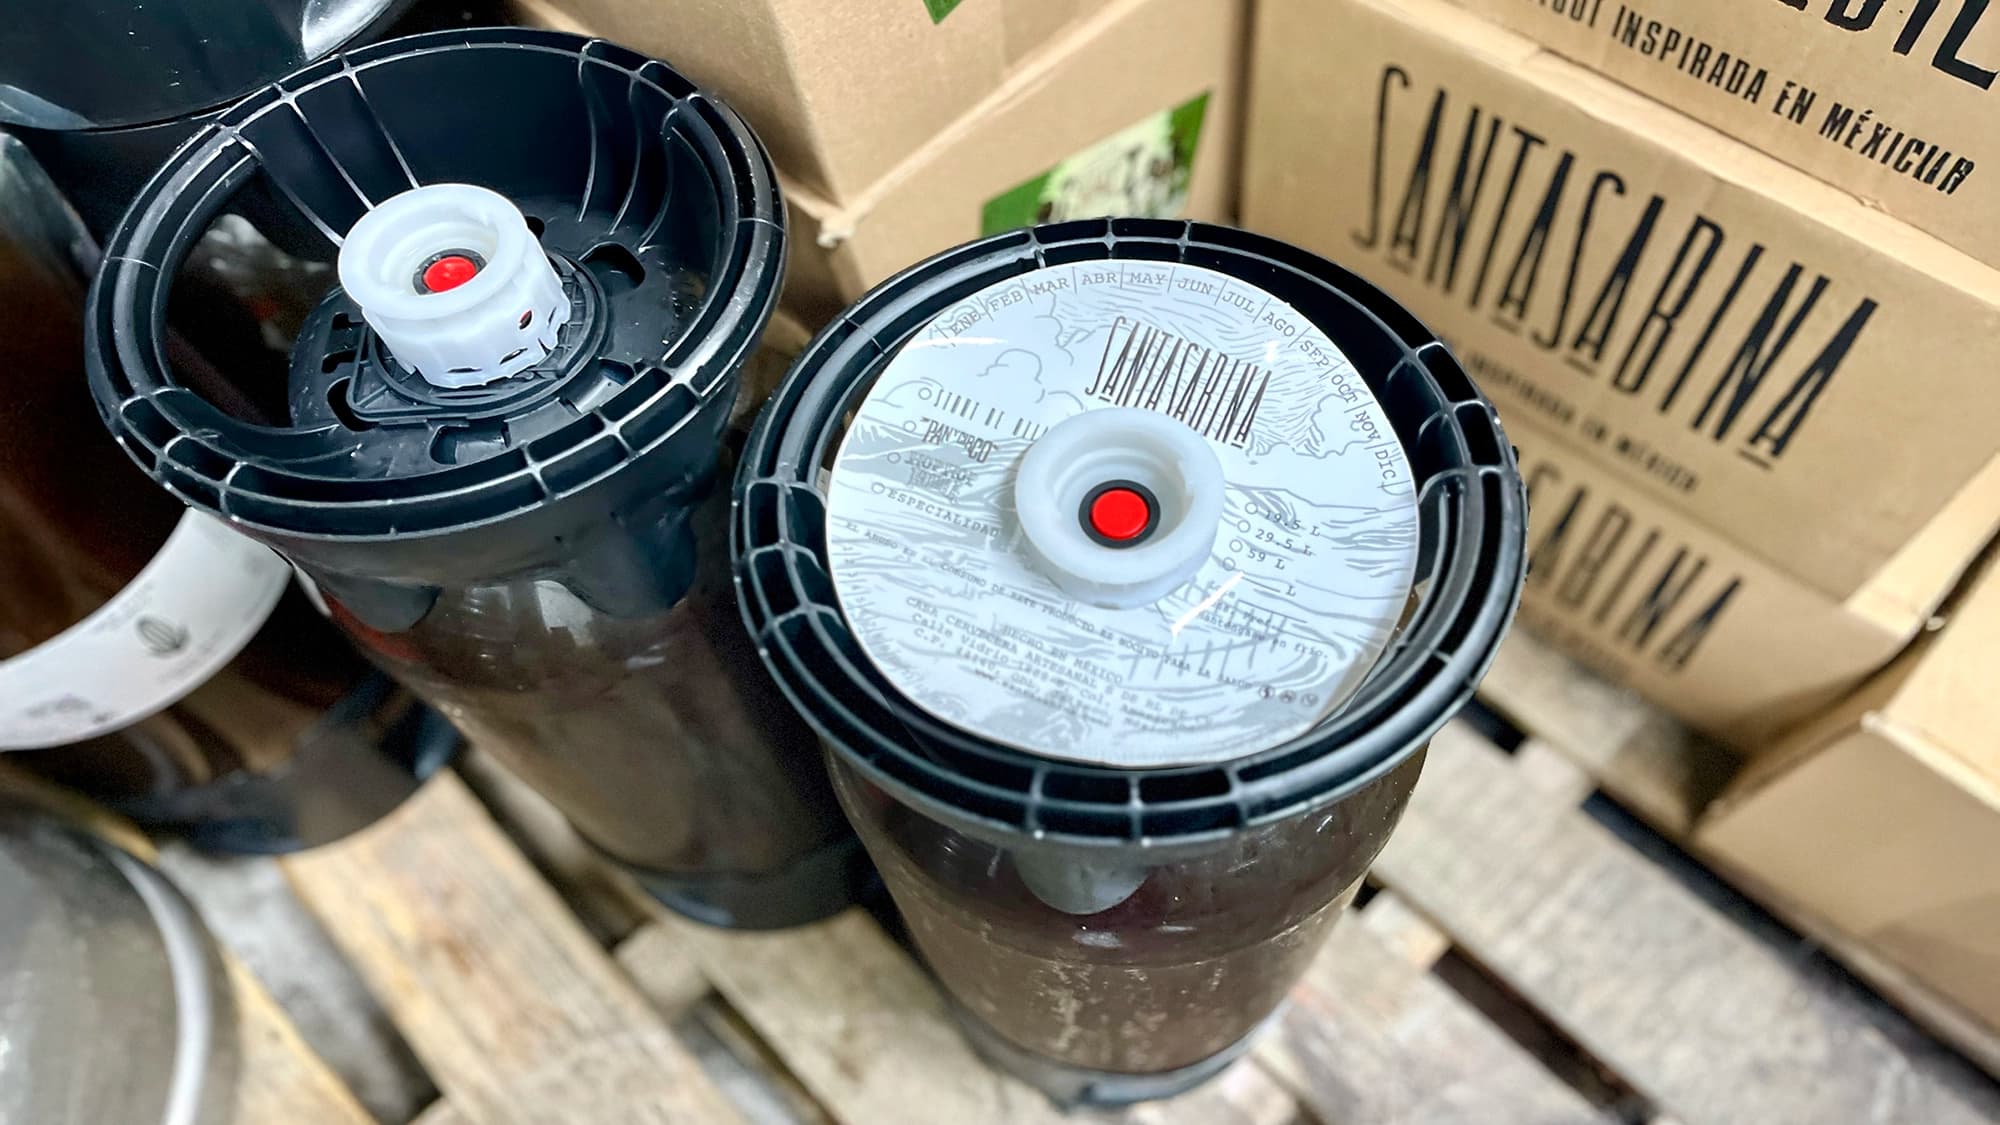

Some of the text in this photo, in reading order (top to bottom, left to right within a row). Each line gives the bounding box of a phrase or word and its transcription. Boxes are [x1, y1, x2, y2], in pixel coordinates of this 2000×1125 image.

[1612, 5, 1768, 104] INSPIRADA
[1772, 80, 1817, 126] EN
[1352, 63, 1879, 472] SANTASABINA
[950, 271, 1397, 479] ENE FEB MAR ABR MAY JUN JUL AGO SEP OCT NOV DIC
[1084, 315, 1272, 449] SANTASABINA
[1264, 509, 1321, 537] 19.5 L
[1255, 528, 1314, 557] 29.5 L
[1247, 548, 1286, 570] 59 L
[1286, 585, 1297, 597] L
[912, 612, 953, 639] Calle
